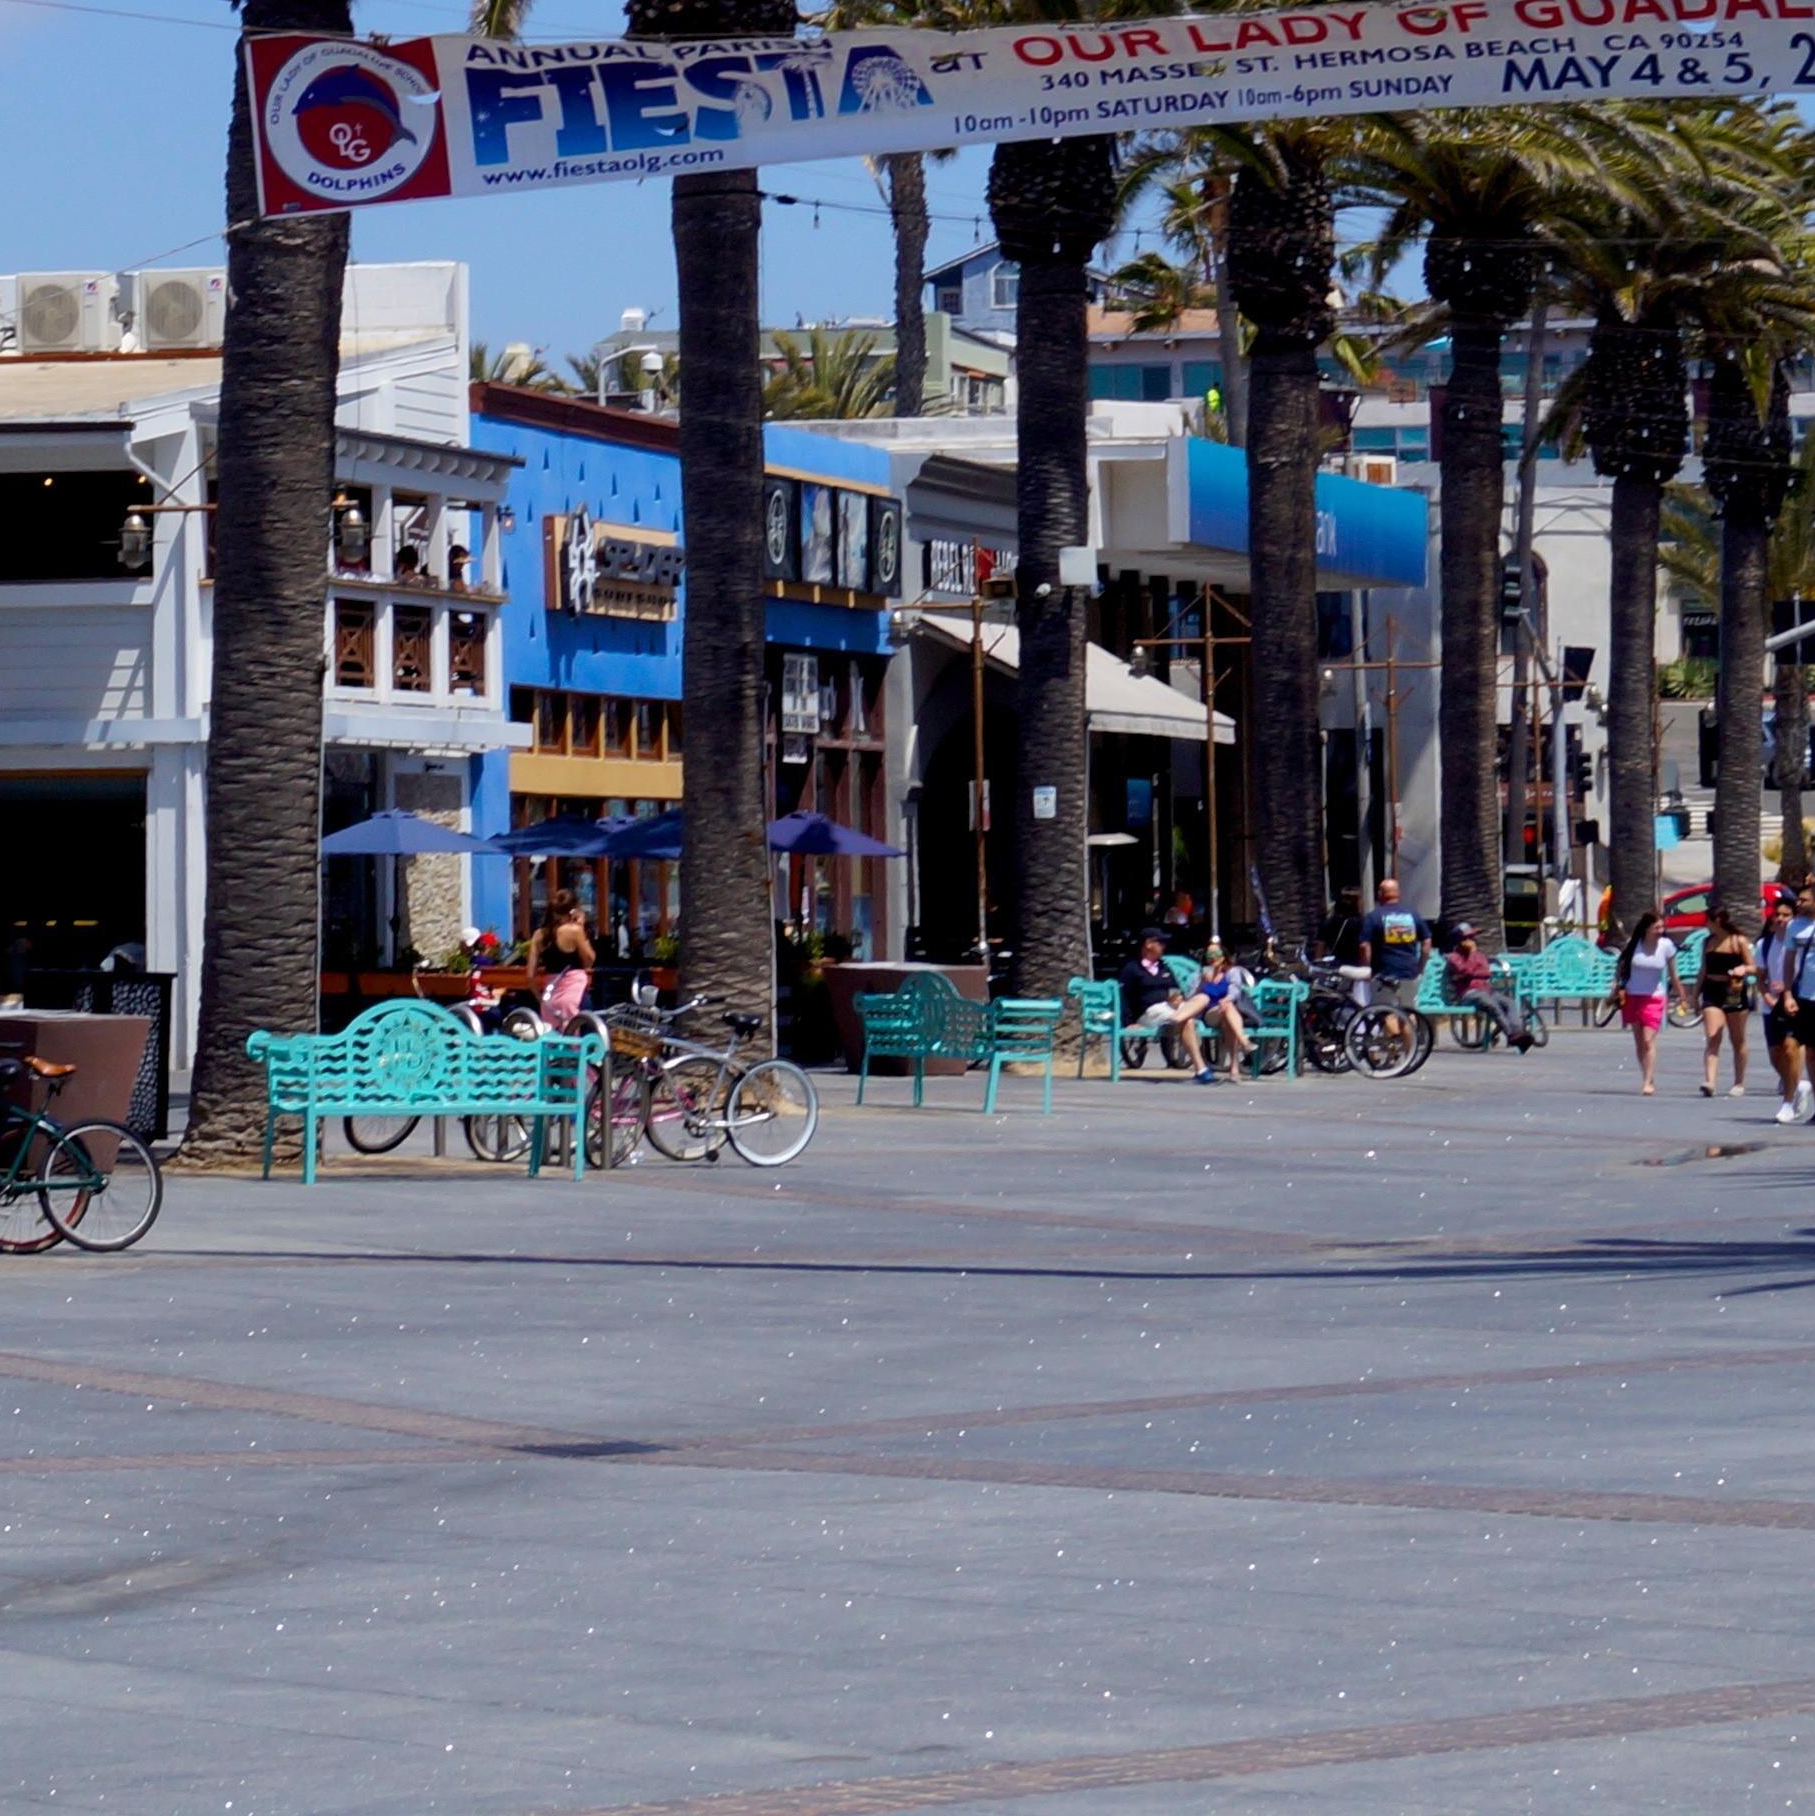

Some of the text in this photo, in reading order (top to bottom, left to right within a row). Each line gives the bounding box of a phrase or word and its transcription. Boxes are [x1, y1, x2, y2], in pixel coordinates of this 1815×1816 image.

[466, 39, 833, 68] ANNUAL PARISH
[1013, 29, 1170, 66] OUR
[1186, 11, 1366, 52] LADY
[1396, 1, 1489, 36] OF
[1041, 30, 1745, 91] 340 MASSE ST. HERMOSA BEACH CA 90254
[1500, 52, 1621, 93] MAY
[1630, 52, 1664, 85] 4
[1676, 56, 1710, 84] &
[465, 46, 934, 166] FIESTA
[1097, 90, 1229, 119] SATURDAY
[1349, 74, 1453, 96] SUNDAY
[307, 163, 406, 191] DOLPHINS
[482, 149, 724, 185] www.fiestaolg.com
